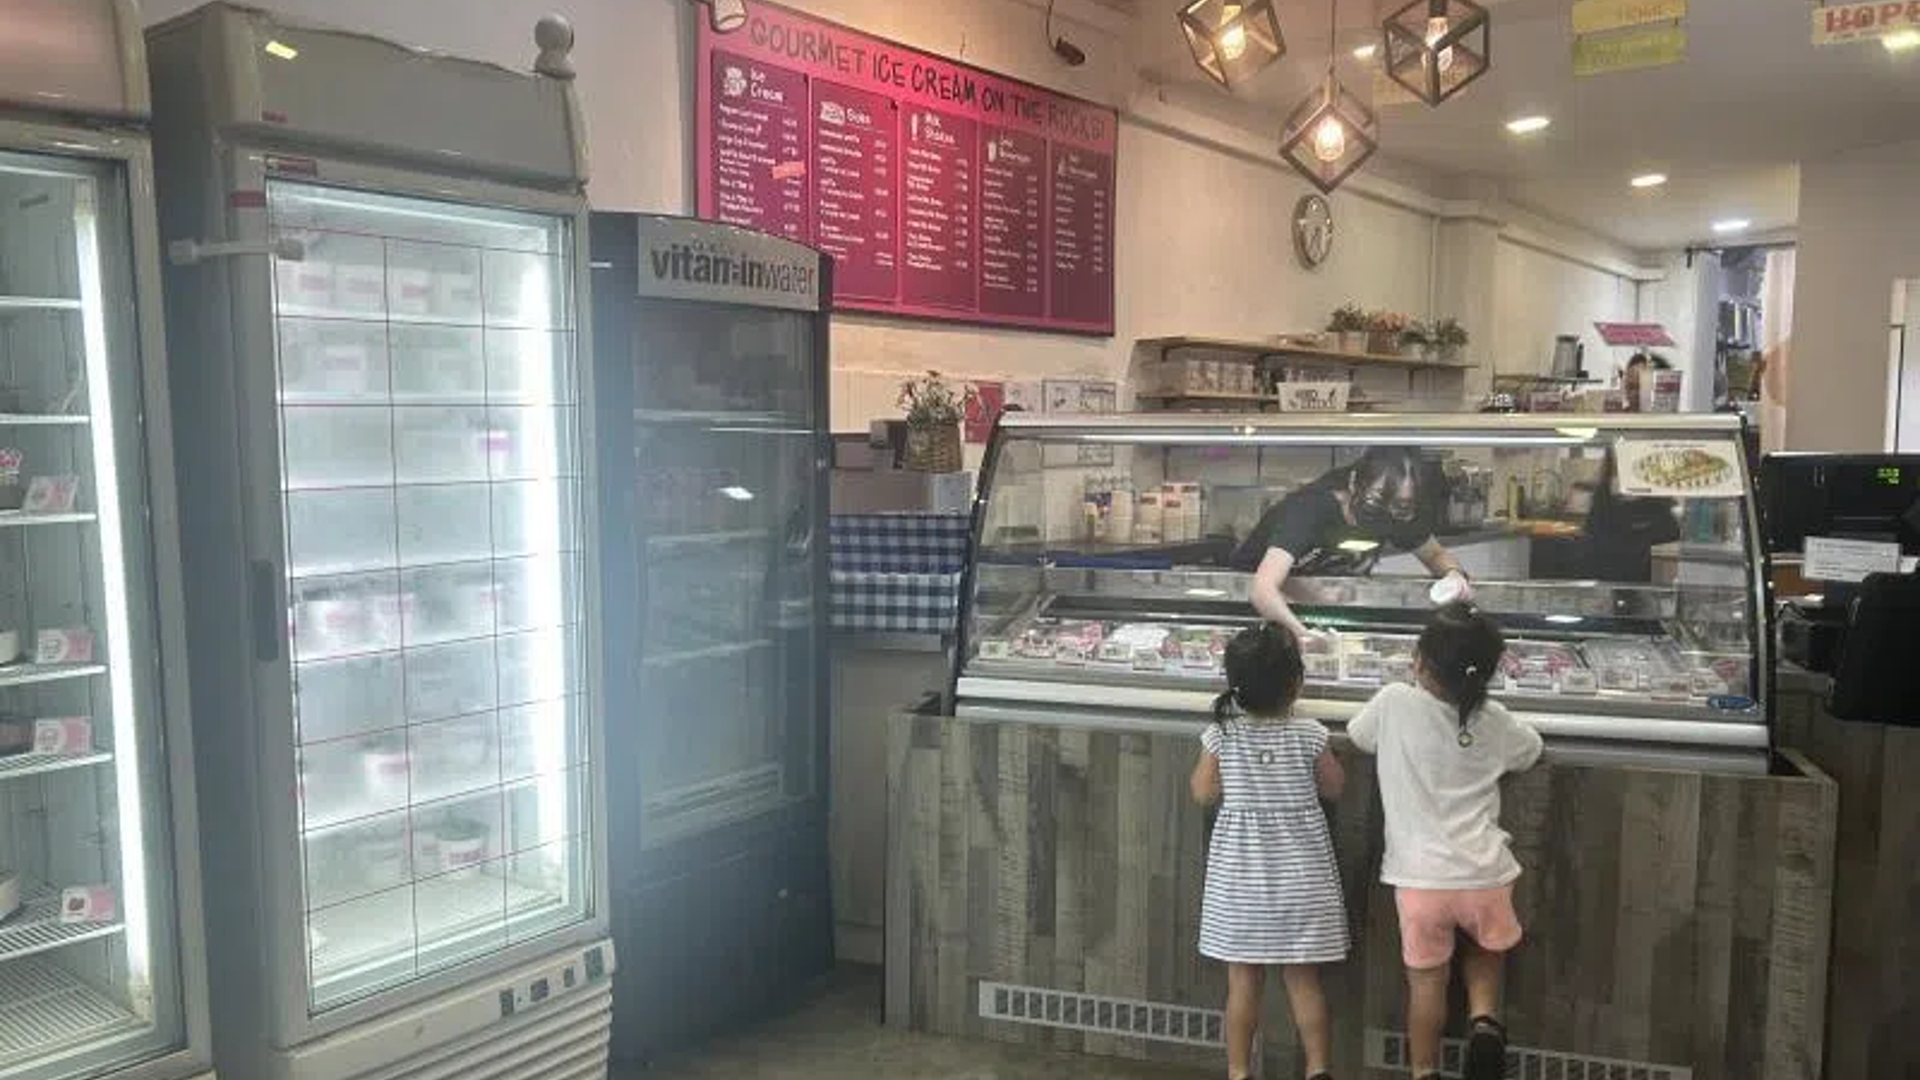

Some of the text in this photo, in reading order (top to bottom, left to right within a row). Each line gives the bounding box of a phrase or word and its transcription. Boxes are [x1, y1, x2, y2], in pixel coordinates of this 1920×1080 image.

[750, 82, 783, 102] Cream
[751, 17, 866, 73] GOURMET
[873, 54, 906, 88] ICE
[911, 64, 975, 106] CREAM
[982, 86, 1005, 114] ON
[1009, 94, 1044, 125] THE
